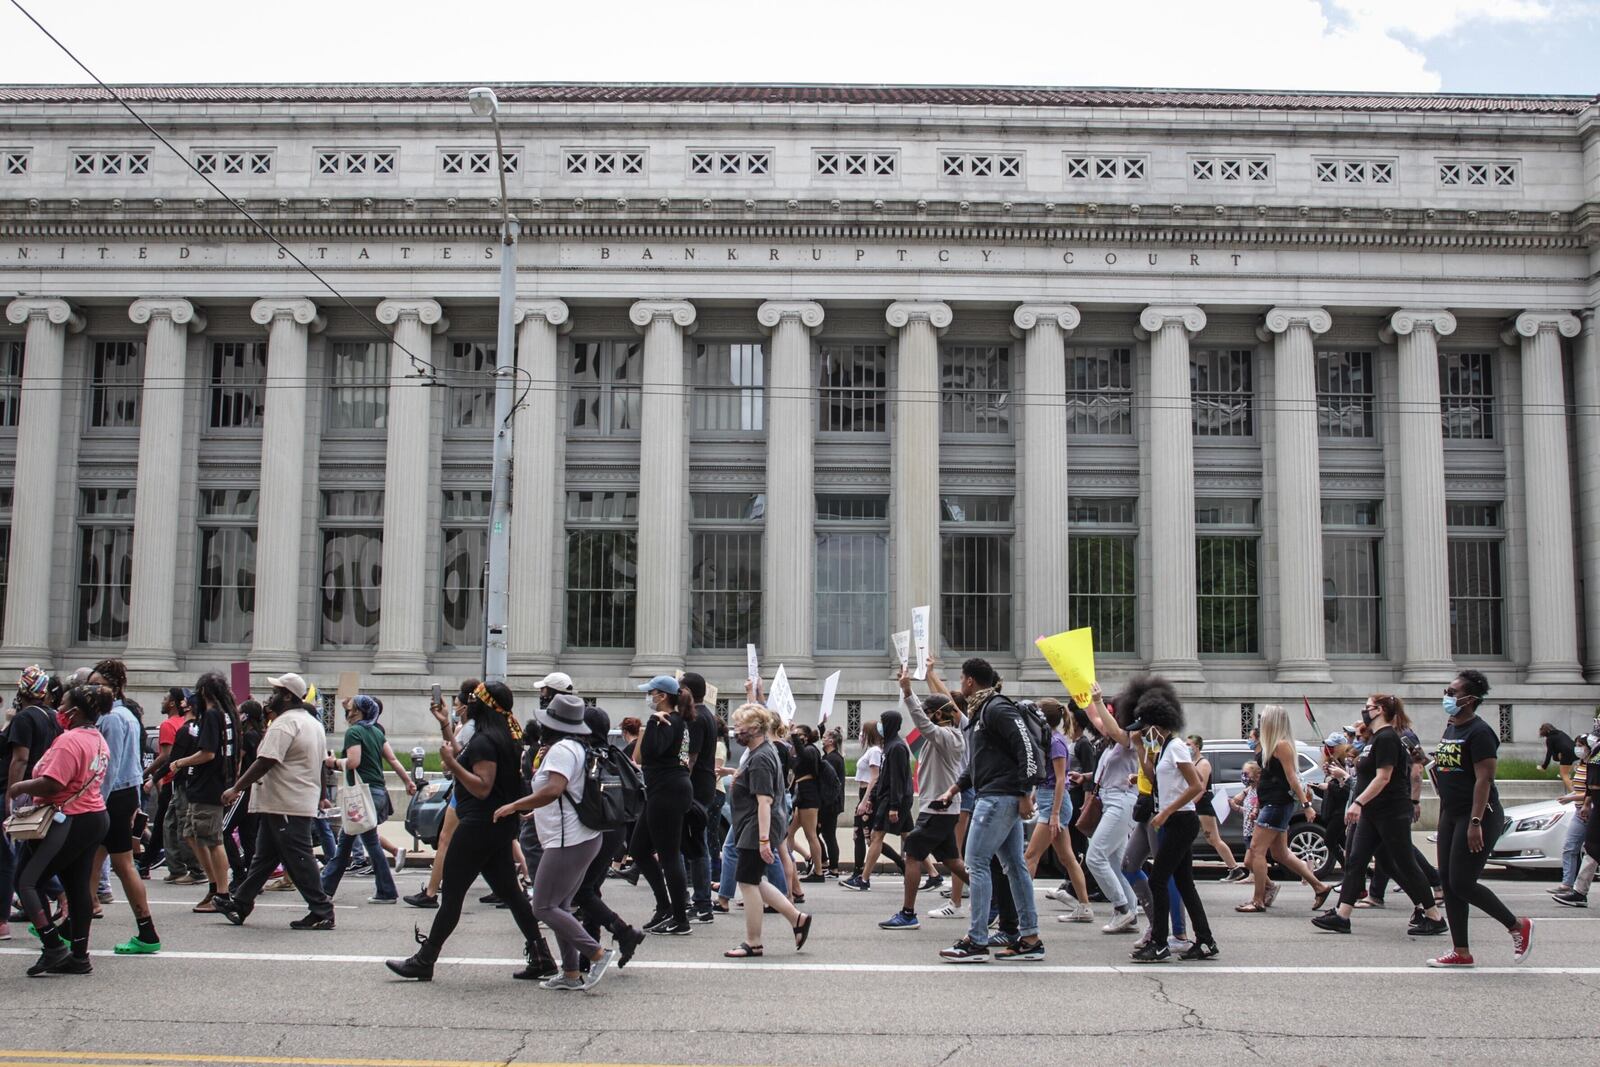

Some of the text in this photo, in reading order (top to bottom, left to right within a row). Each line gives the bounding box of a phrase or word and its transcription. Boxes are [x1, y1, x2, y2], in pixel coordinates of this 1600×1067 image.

[276, 246, 494, 260] STATES
[600, 247, 992, 262] BANKRUPTCY
[1062, 251, 1241, 266] COURT
[1014, 718, 1038, 778] Dreamville
